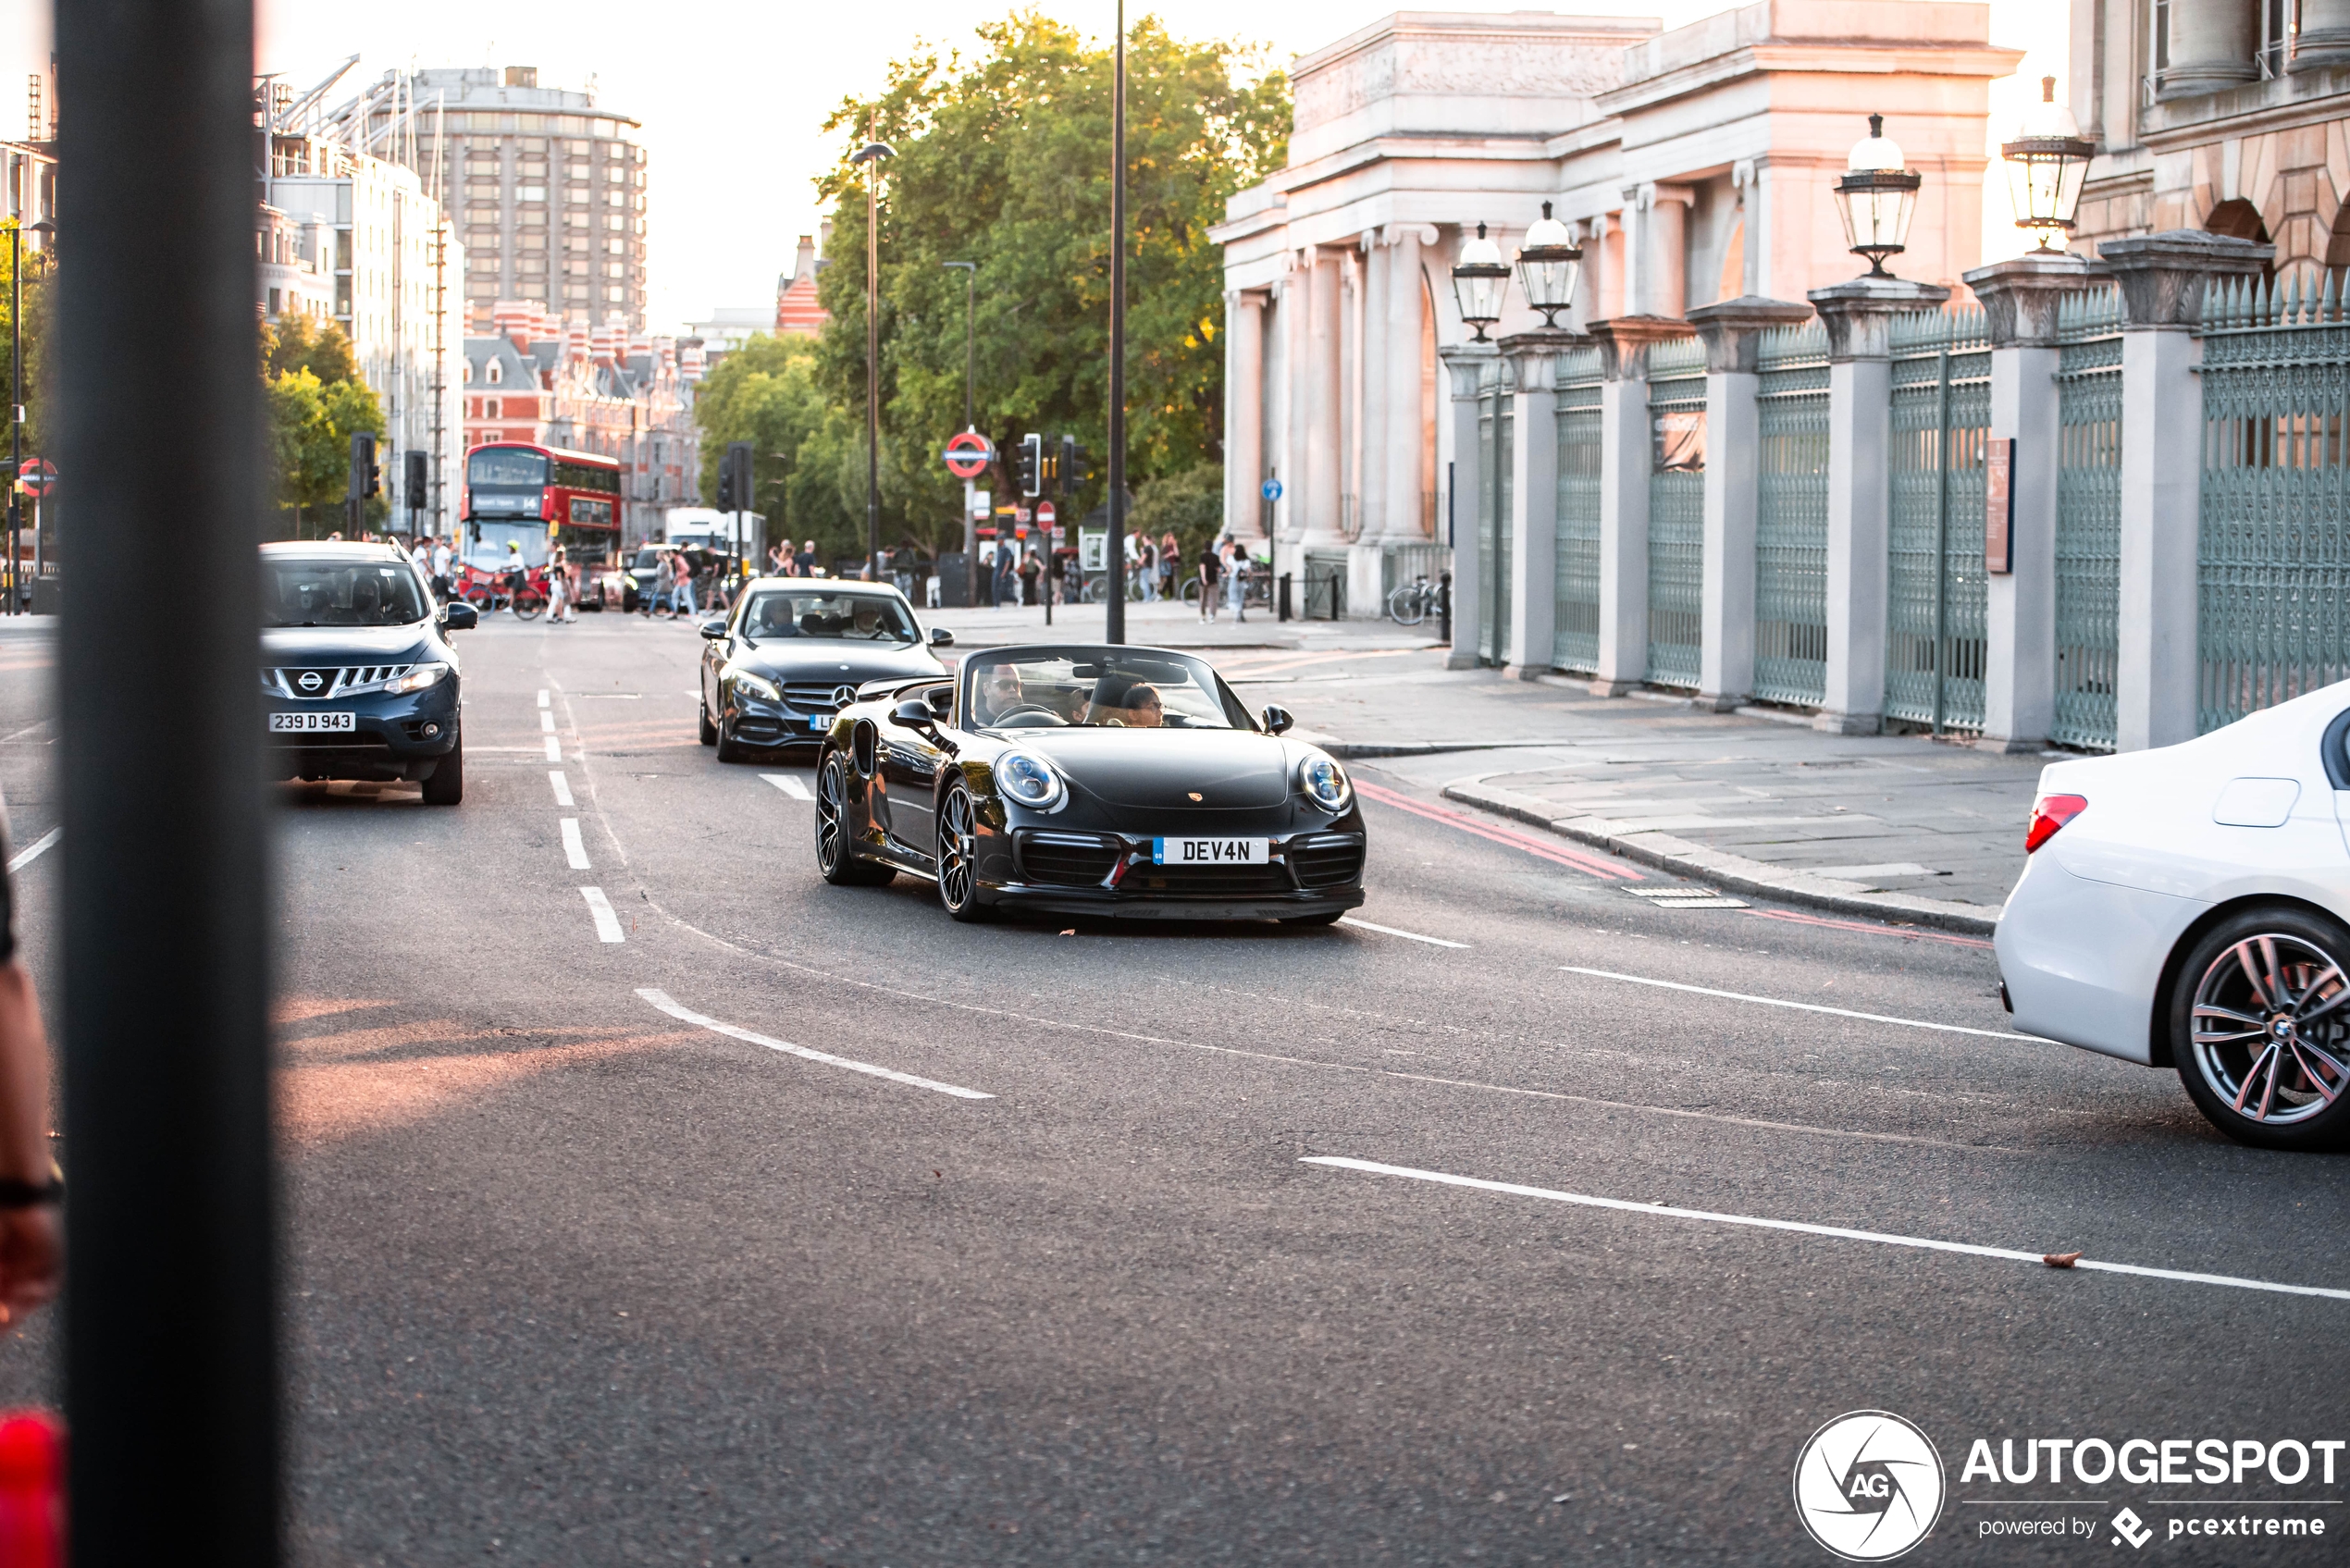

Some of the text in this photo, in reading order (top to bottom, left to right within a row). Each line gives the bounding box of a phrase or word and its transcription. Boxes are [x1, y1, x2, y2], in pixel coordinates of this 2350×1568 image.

[523, 497, 538, 509] 14
[275, 714, 351, 729] 239 D 943
[1183, 841, 1250, 861] DEV4N
